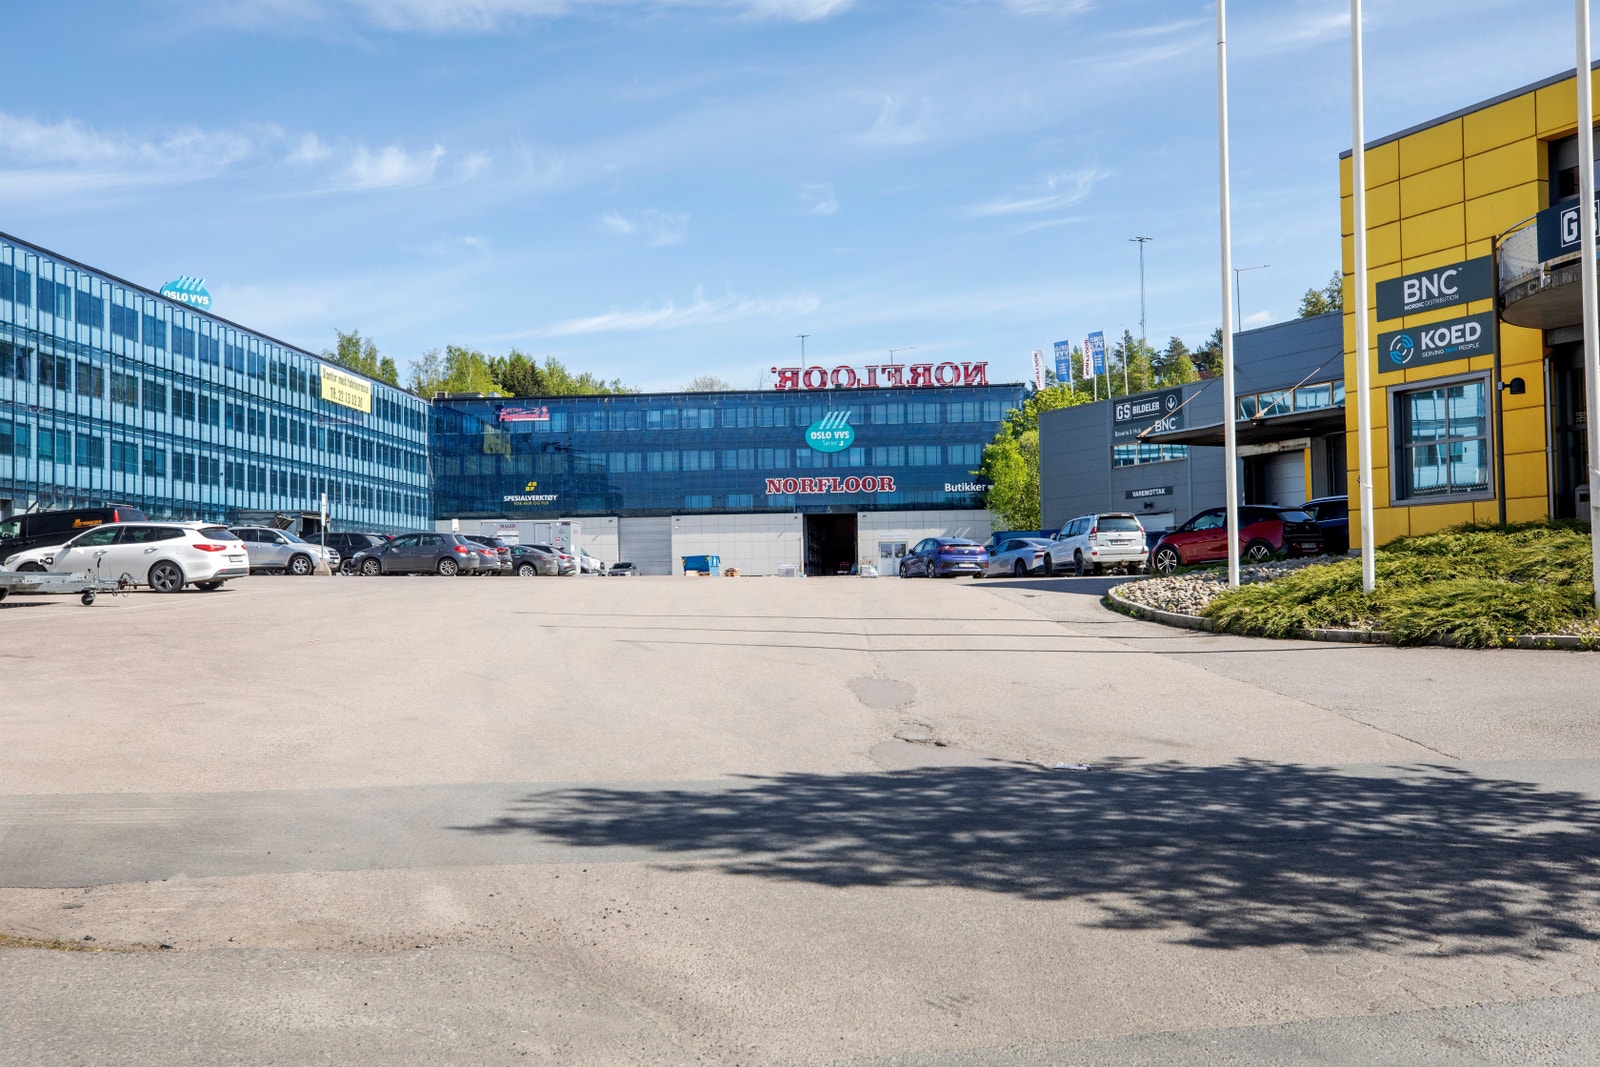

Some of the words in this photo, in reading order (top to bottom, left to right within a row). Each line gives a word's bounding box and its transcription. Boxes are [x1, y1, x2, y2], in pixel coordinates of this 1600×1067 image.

[1403, 269, 1458, 304] BNC
[163, 290, 189, 302] OSLO
[190, 294, 209, 305] VVS
[1404, 301, 1425, 311] NORDIC
[1424, 294, 1459, 307] DISTRIBUTION
[1421, 322, 1481, 350] KOED
[1421, 349, 1445, 358] SERVING
[1458, 341, 1480, 351] PEOPLE
[1116, 404, 1131, 420] GS
[1132, 401, 1160, 415] BILDELER
[1154, 417, 1176, 432] BNC
[810, 431, 832, 440] OSLO
[834, 430, 850, 439] VVS
[765, 476, 896, 495] NORFLOOR
[944, 482, 987, 492] Butikker
[1131, 487, 1166, 498] VAREMOTTAK
[503, 494, 558, 502] SPESIALVERKTØY
